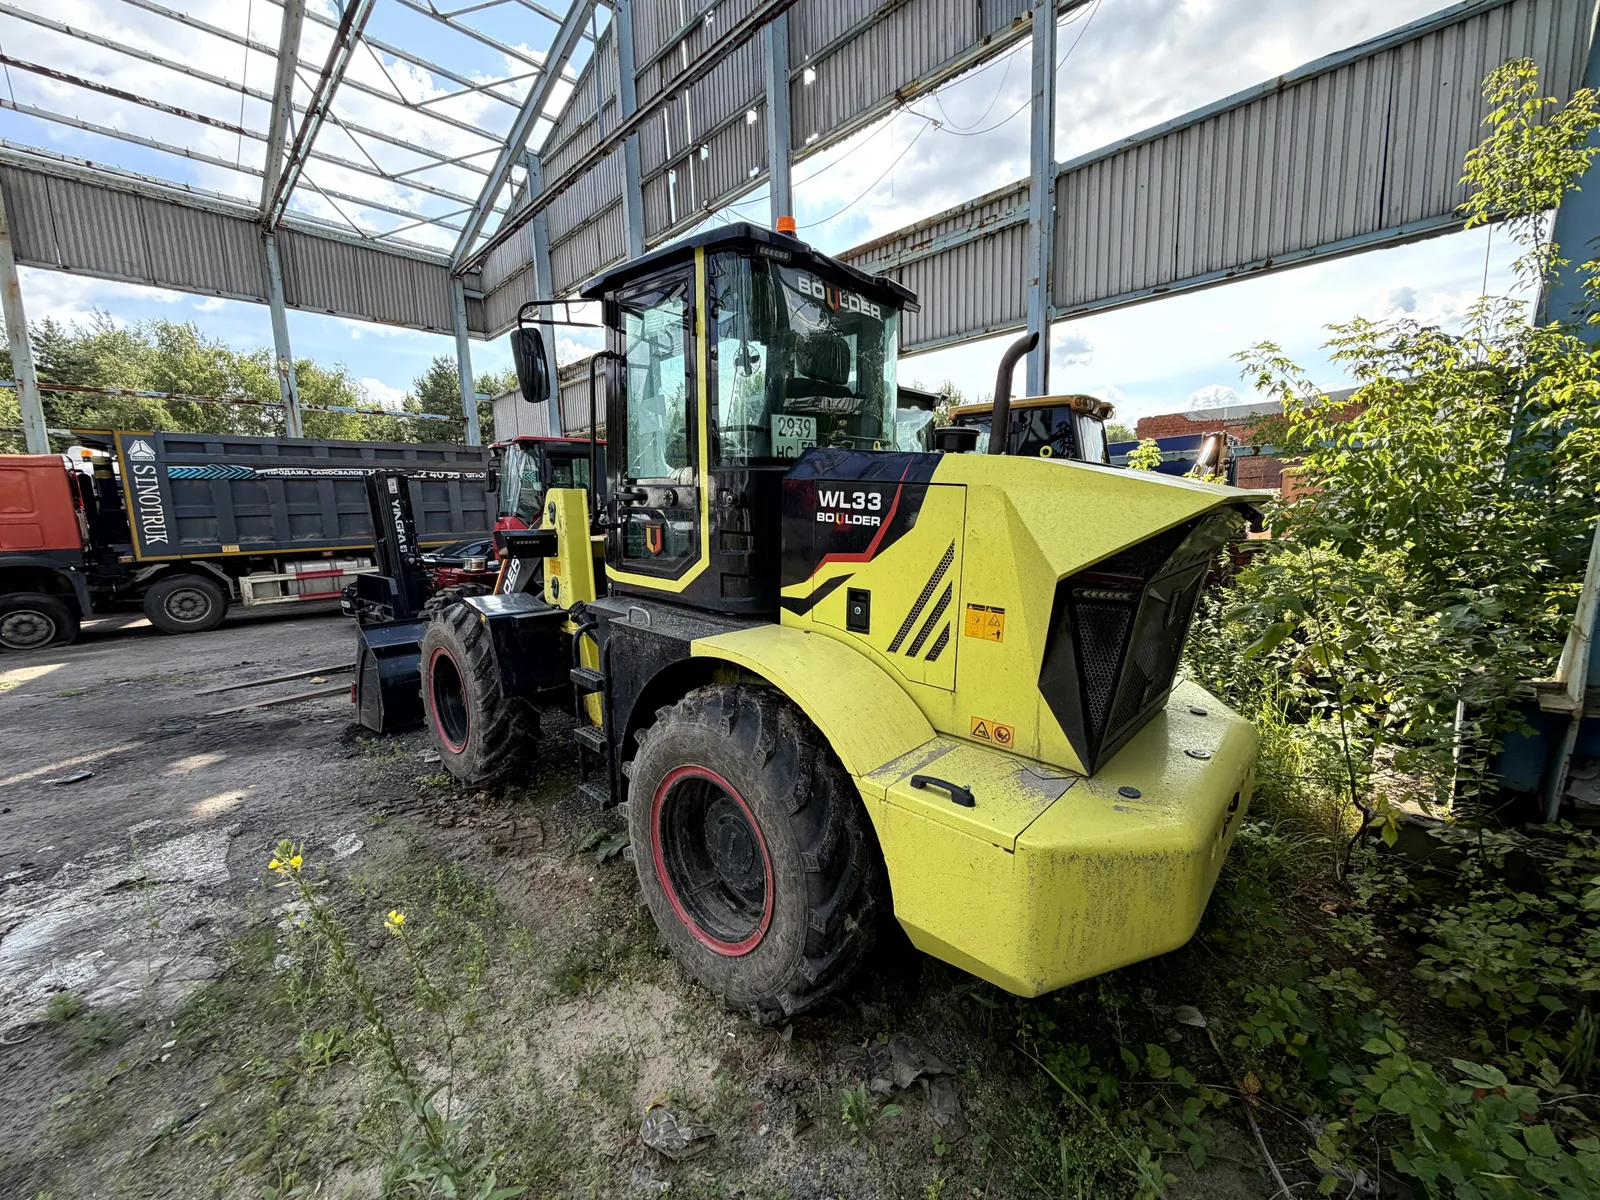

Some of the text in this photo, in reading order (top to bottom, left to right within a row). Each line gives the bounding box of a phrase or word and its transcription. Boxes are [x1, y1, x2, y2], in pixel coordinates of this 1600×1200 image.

[797, 276, 884, 322] BOULDER
[778, 416, 811, 438] 2939
[266, 468, 310, 477] ПРОДАЖА
[310, 469, 364, 477] САМОСВАЛОВ
[132, 464, 169, 546] SINOTRUK
[818, 490, 882, 511] WL33
[816, 512, 881, 527] BOULDER
